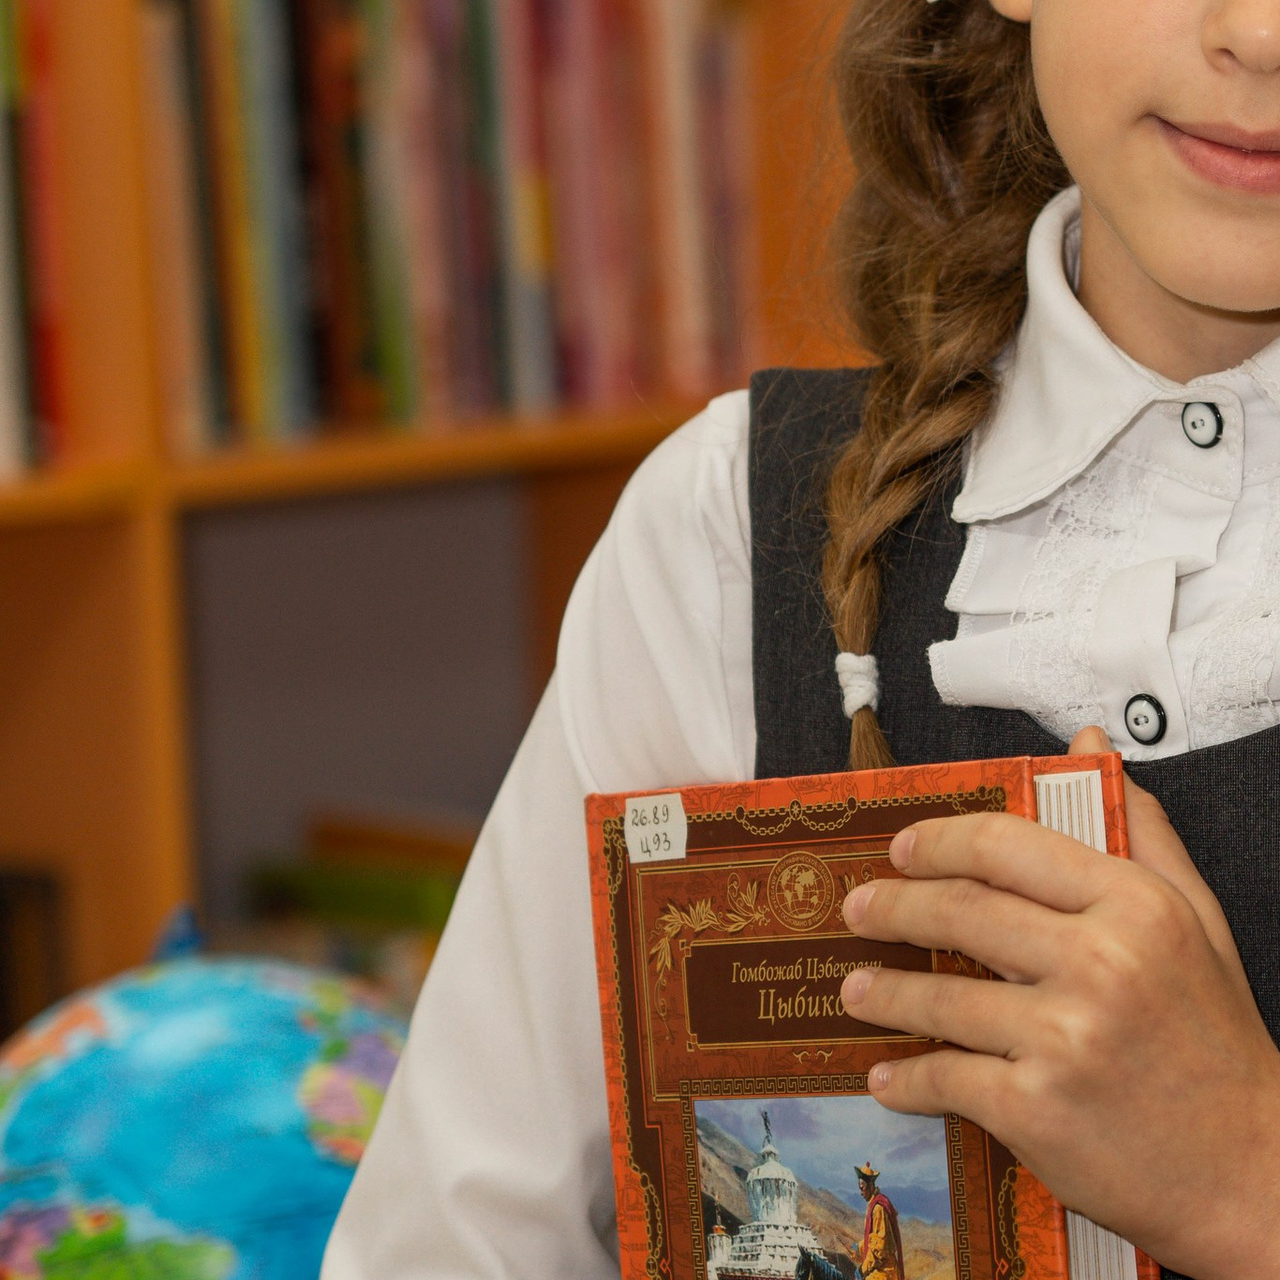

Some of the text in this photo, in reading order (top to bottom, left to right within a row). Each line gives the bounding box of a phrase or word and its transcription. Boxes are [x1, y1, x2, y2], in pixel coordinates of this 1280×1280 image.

[631, 804, 669, 826] 26.89
[731, 958, 803, 983] Гомбожаб
[758, 985, 846, 1025] Цыбико
